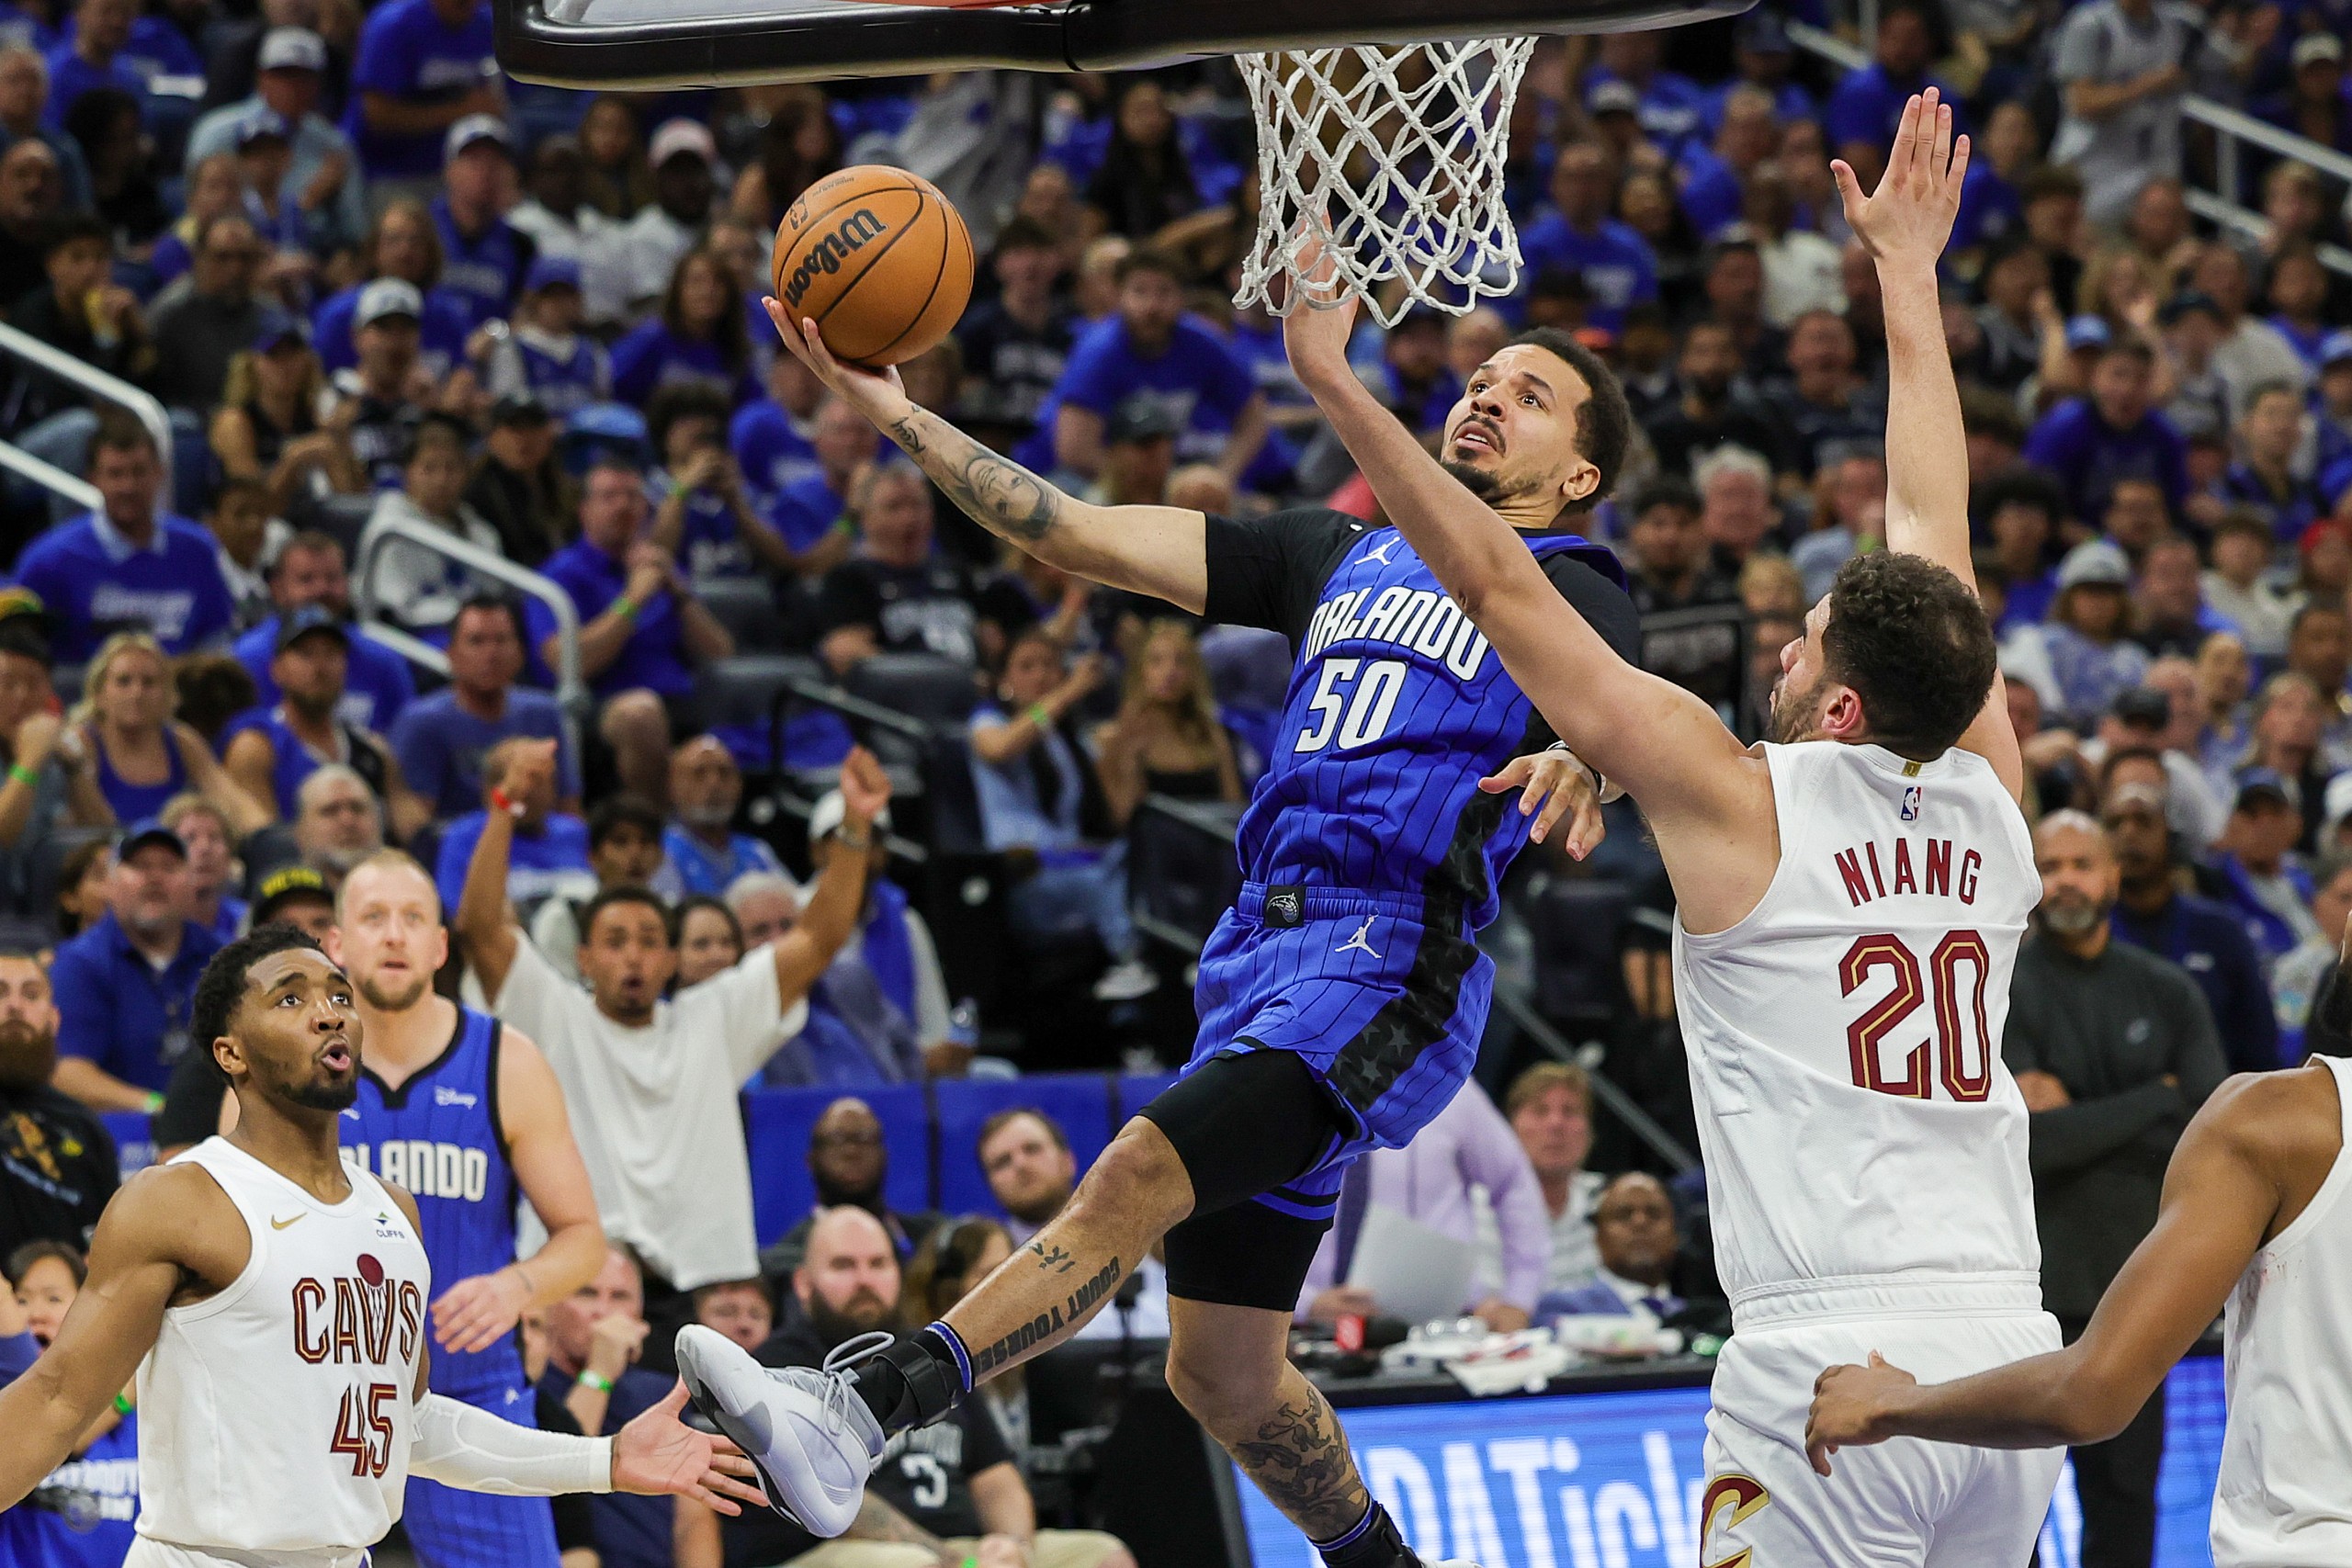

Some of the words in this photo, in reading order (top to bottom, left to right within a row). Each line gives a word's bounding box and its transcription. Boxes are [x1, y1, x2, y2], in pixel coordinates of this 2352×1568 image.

[785, 209, 889, 310] Wilson
[1305, 585, 1489, 682] ORLANDO
[1294, 658, 1408, 753] 50
[1834, 837, 1983, 908] NIANG
[1838, 930, 1992, 1102] 20
[339, 1139, 489, 1202] LANDO
[376, 1228, 406, 1240] CLIFFS
[292, 1276, 422, 1366] CAVS
[1068, 1256, 1121, 1323] COUNT
[330, 1382, 397, 1479] 45
